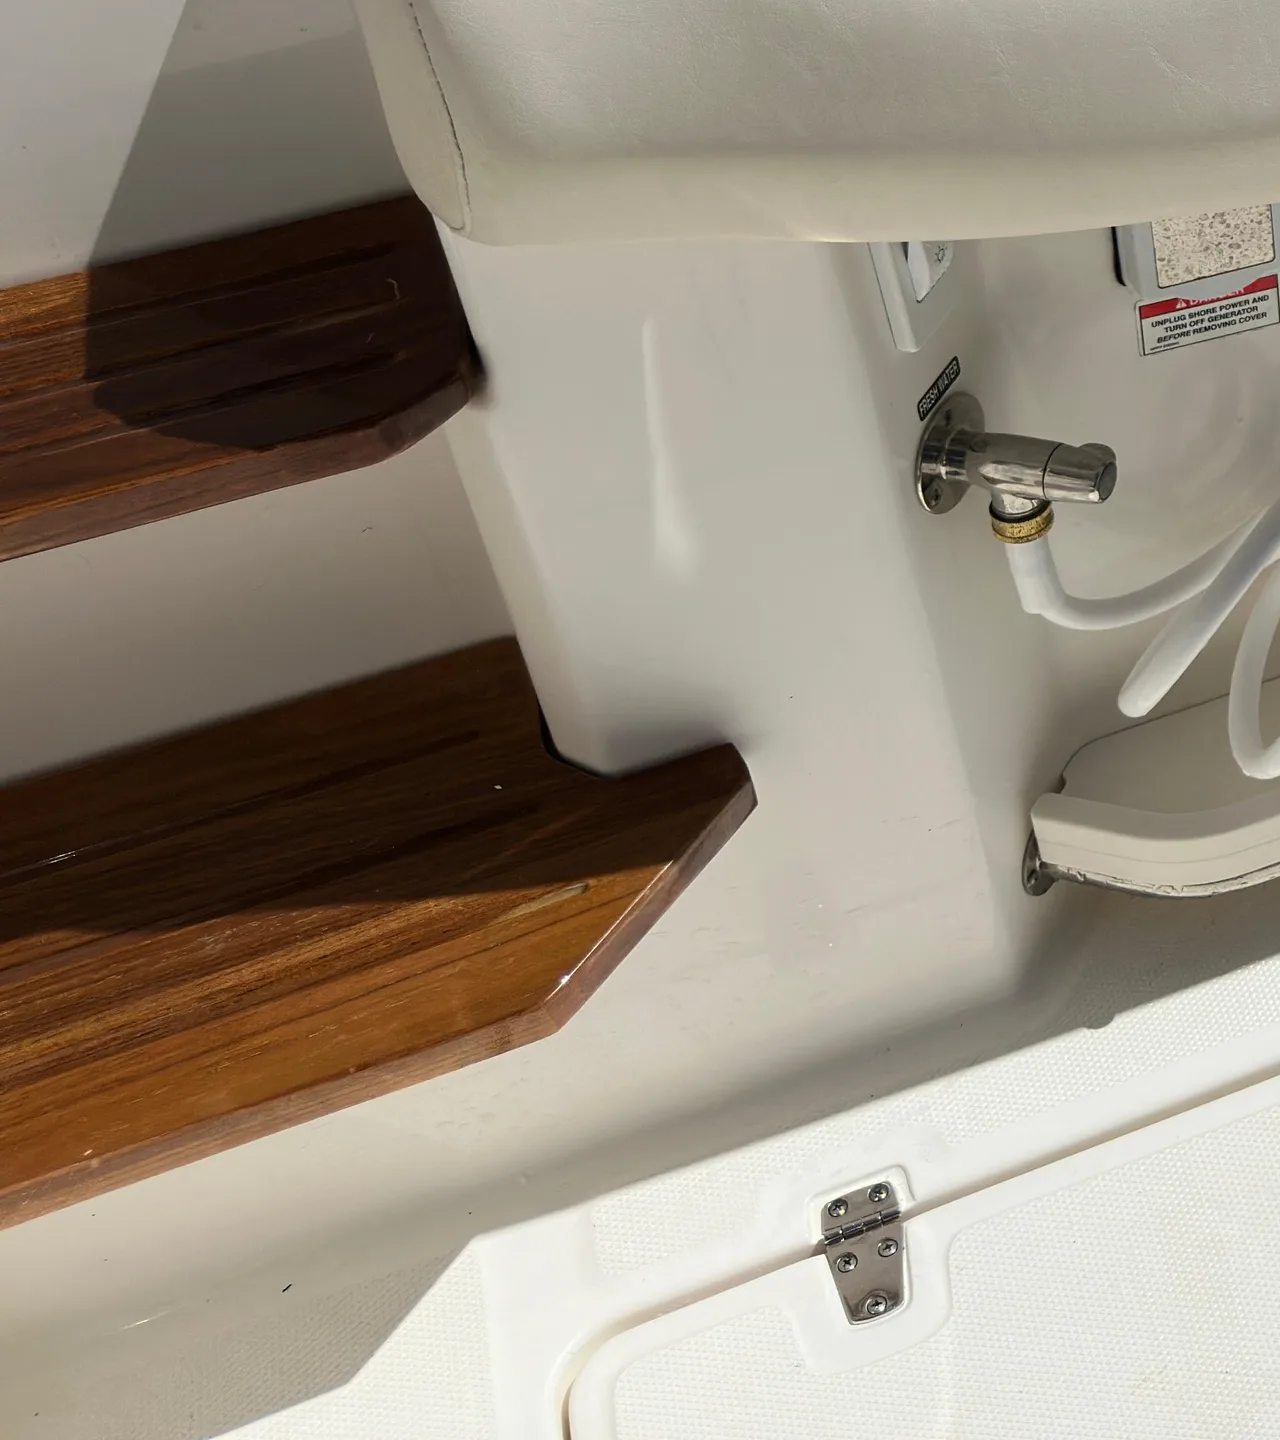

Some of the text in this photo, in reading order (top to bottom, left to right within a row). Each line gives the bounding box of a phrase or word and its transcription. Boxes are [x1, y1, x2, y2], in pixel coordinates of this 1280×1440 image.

[1151, 314, 1187, 328] UNPLUG
[1188, 306, 1218, 318] SHORE
[1219, 298, 1250, 311] POWER
[1252, 294, 1269, 304] AND
[1157, 311, 1267, 344] BEFORE REMOVING COVER
[1163, 305, 1258, 333] TURN OFF GENERATOR
[919, 360, 959, 418] FRESH WATER
